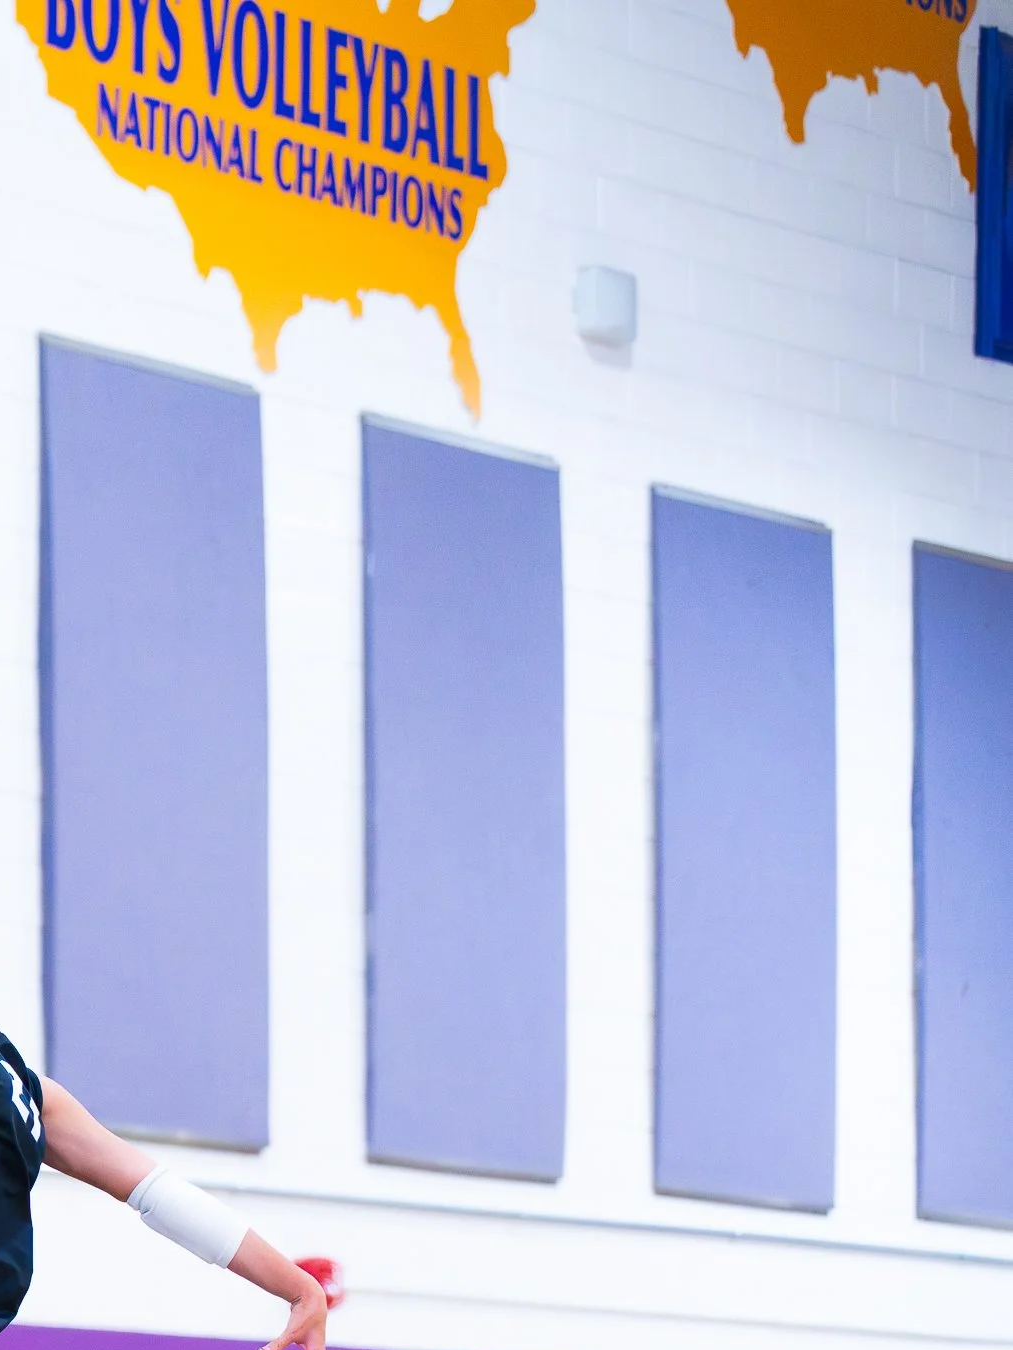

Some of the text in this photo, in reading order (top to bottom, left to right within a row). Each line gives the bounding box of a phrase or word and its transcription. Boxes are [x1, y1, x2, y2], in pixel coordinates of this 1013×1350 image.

[97, 83, 464, 242] NATIONAL CHAMPIONS
[201, 0, 487, 180] VOLLEYBALL
